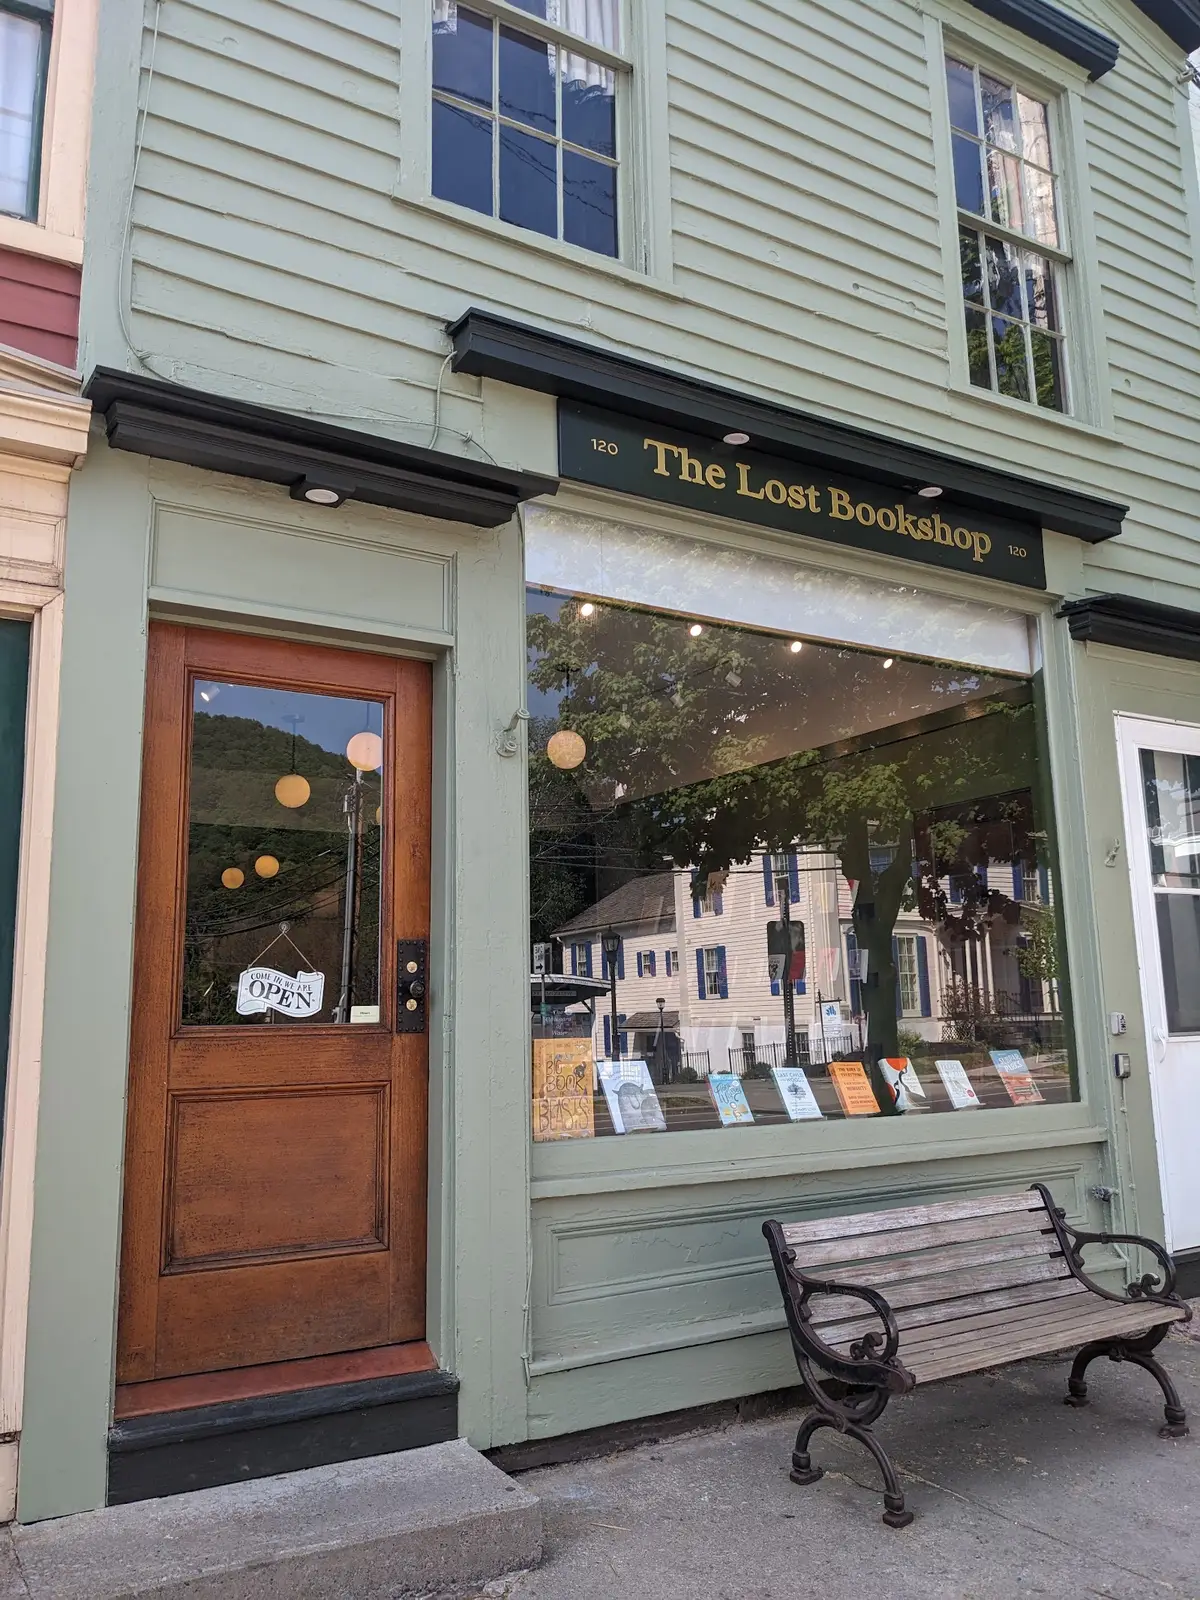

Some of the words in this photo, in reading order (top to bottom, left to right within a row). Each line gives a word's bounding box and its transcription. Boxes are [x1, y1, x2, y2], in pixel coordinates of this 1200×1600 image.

[591, 438, 619, 456] 120
[643, 437, 726, 490] The
[735, 462, 821, 513] Lost
[828, 486, 993, 563] Bookshop
[1007, 544, 1028, 559] 120
[250, 972, 272, 981] COME
[284, 981, 295, 990] WE
[297, 984, 312, 992] ARE
[249, 980, 313, 1009] OPEN
[545, 1060, 563, 1076] BIG
[546, 1074, 584, 1093] BOOK
[539, 1097, 589, 1133] BEASTS
